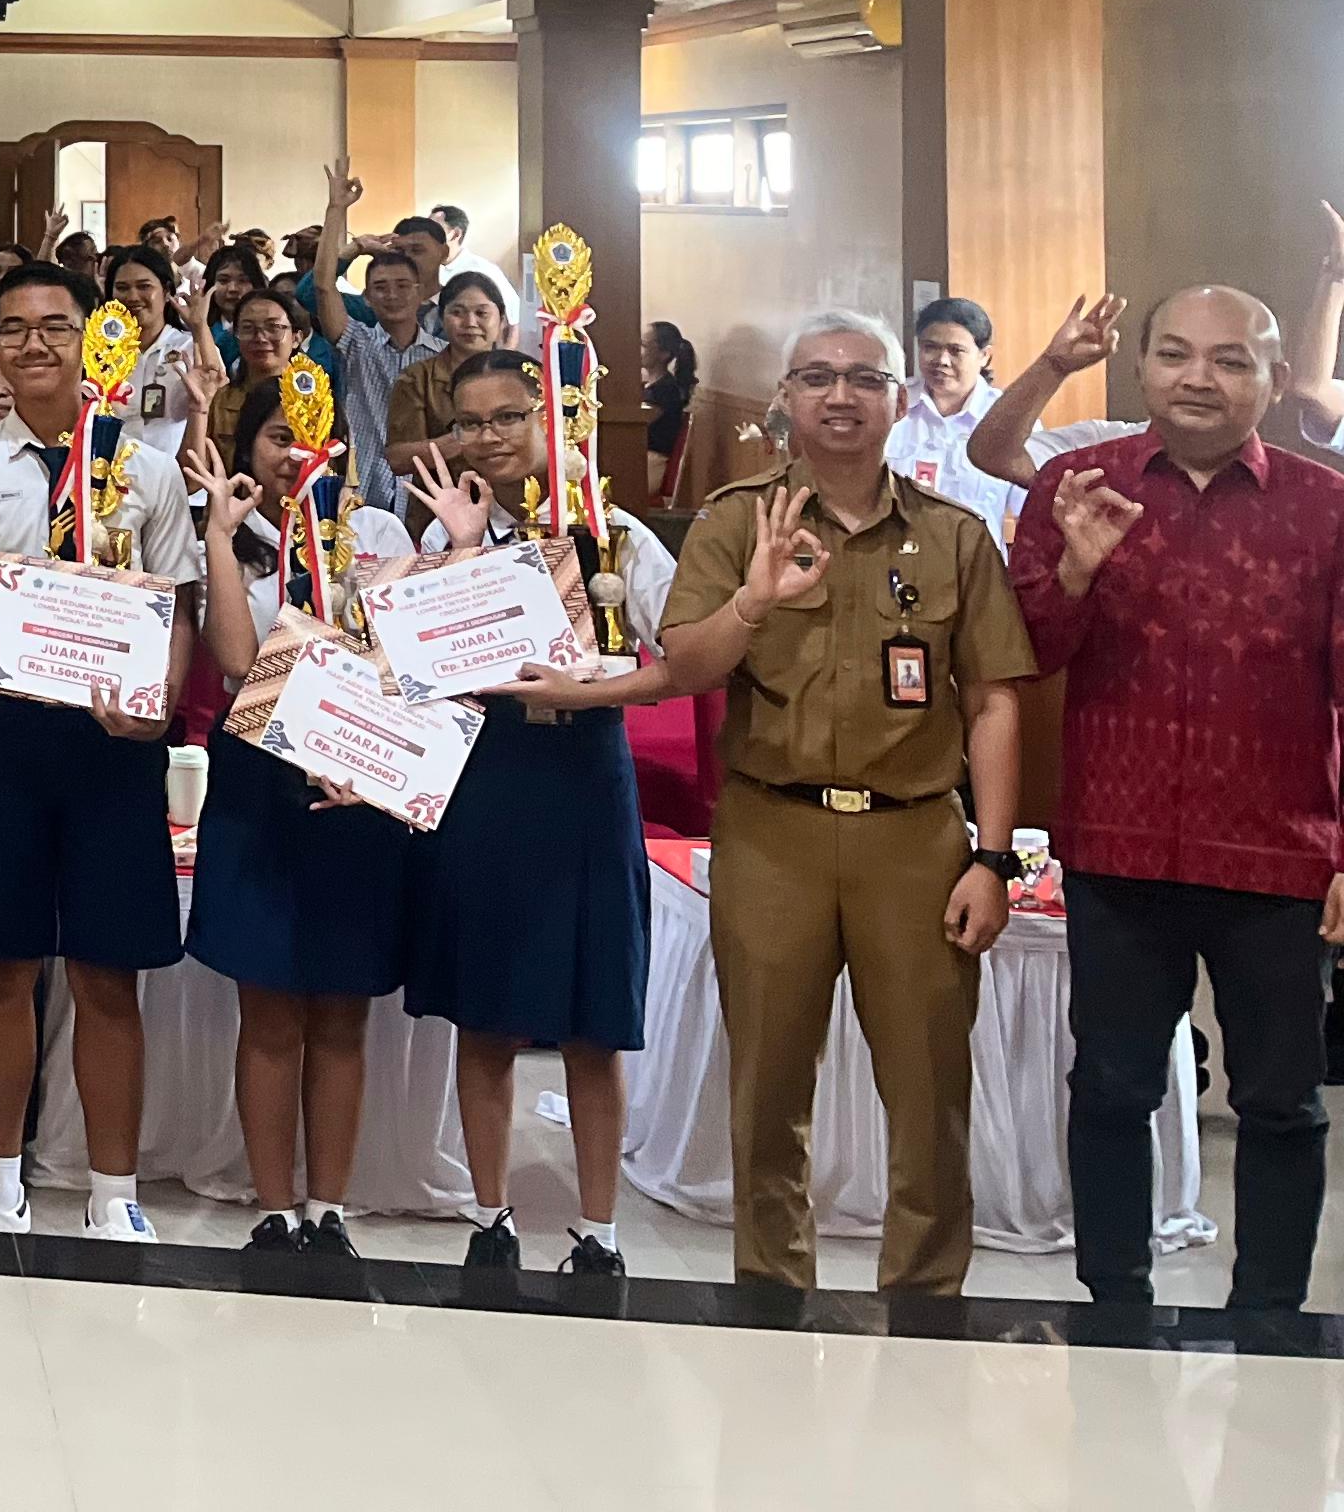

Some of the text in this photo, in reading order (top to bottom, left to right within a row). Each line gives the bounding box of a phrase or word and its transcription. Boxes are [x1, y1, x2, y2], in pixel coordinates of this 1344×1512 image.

[41, 643, 105, 666] JUARA III
[448, 630, 497, 652] JUARA
[440, 642, 528, 674] Rp. 2.000.0000
[28, 661, 113, 686] Rp. 1.500.0000
[333, 725, 383, 755] JUARA
[313, 737, 398, 784] Rp. 1.750.0000
